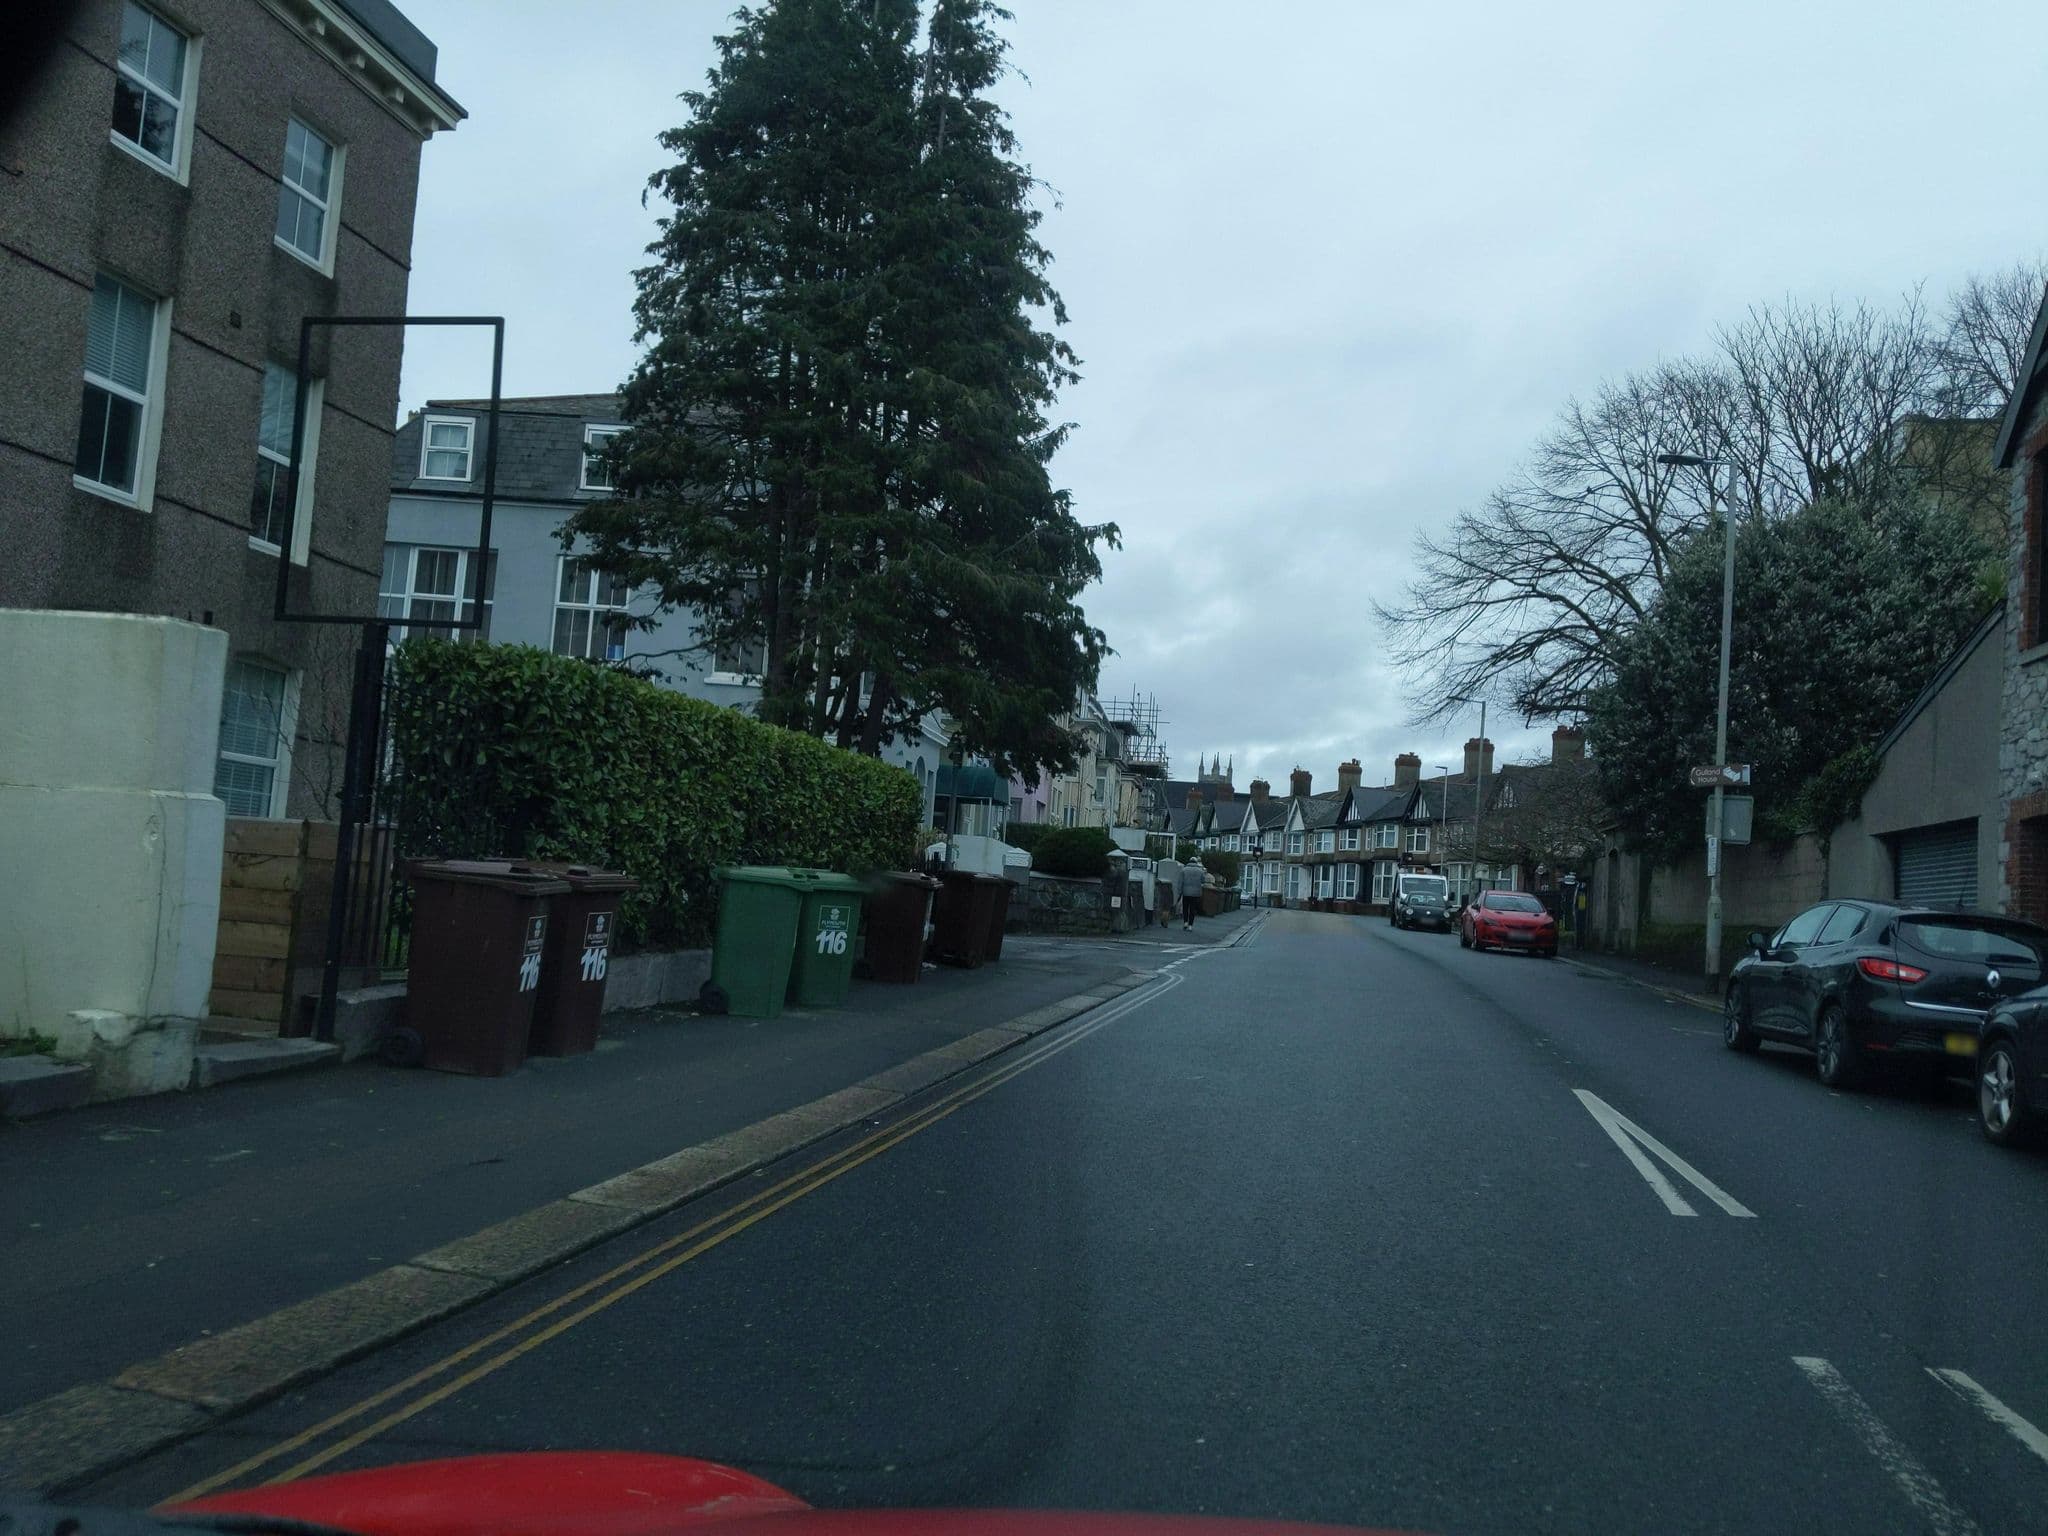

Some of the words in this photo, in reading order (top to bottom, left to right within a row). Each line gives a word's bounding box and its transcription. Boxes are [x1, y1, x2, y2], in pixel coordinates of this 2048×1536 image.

[816, 929, 847, 954] 116
[519, 954, 541, 992] 116
[580, 948, 607, 981] 116
